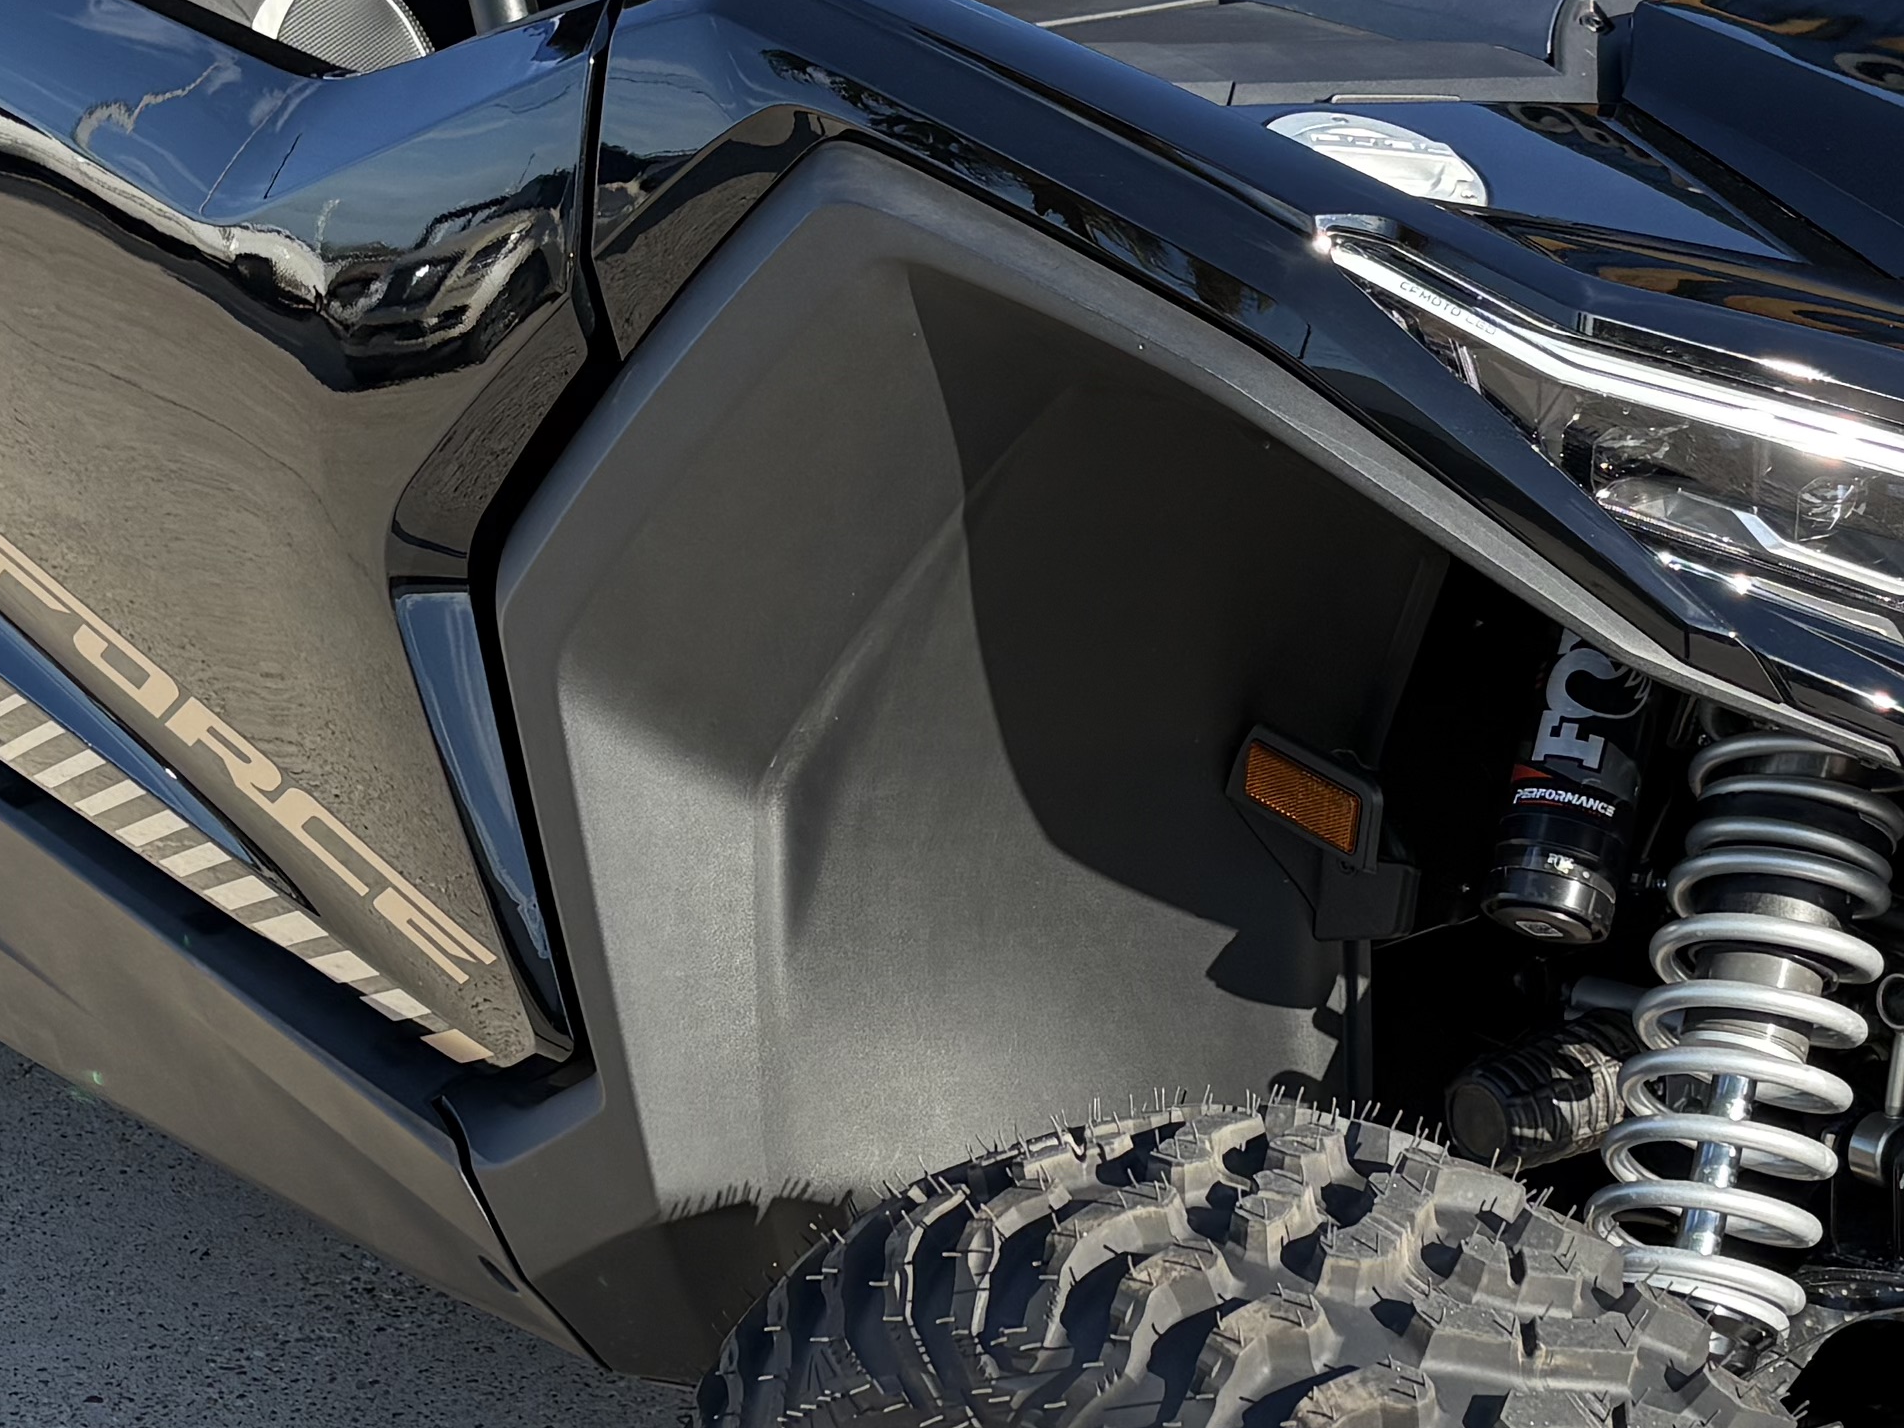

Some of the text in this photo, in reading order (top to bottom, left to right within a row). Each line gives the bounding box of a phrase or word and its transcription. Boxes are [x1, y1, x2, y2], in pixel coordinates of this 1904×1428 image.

[1399, 280, 1498, 336] CFMOTO LED
[1512, 787, 1617, 818] PERFORMANCE
